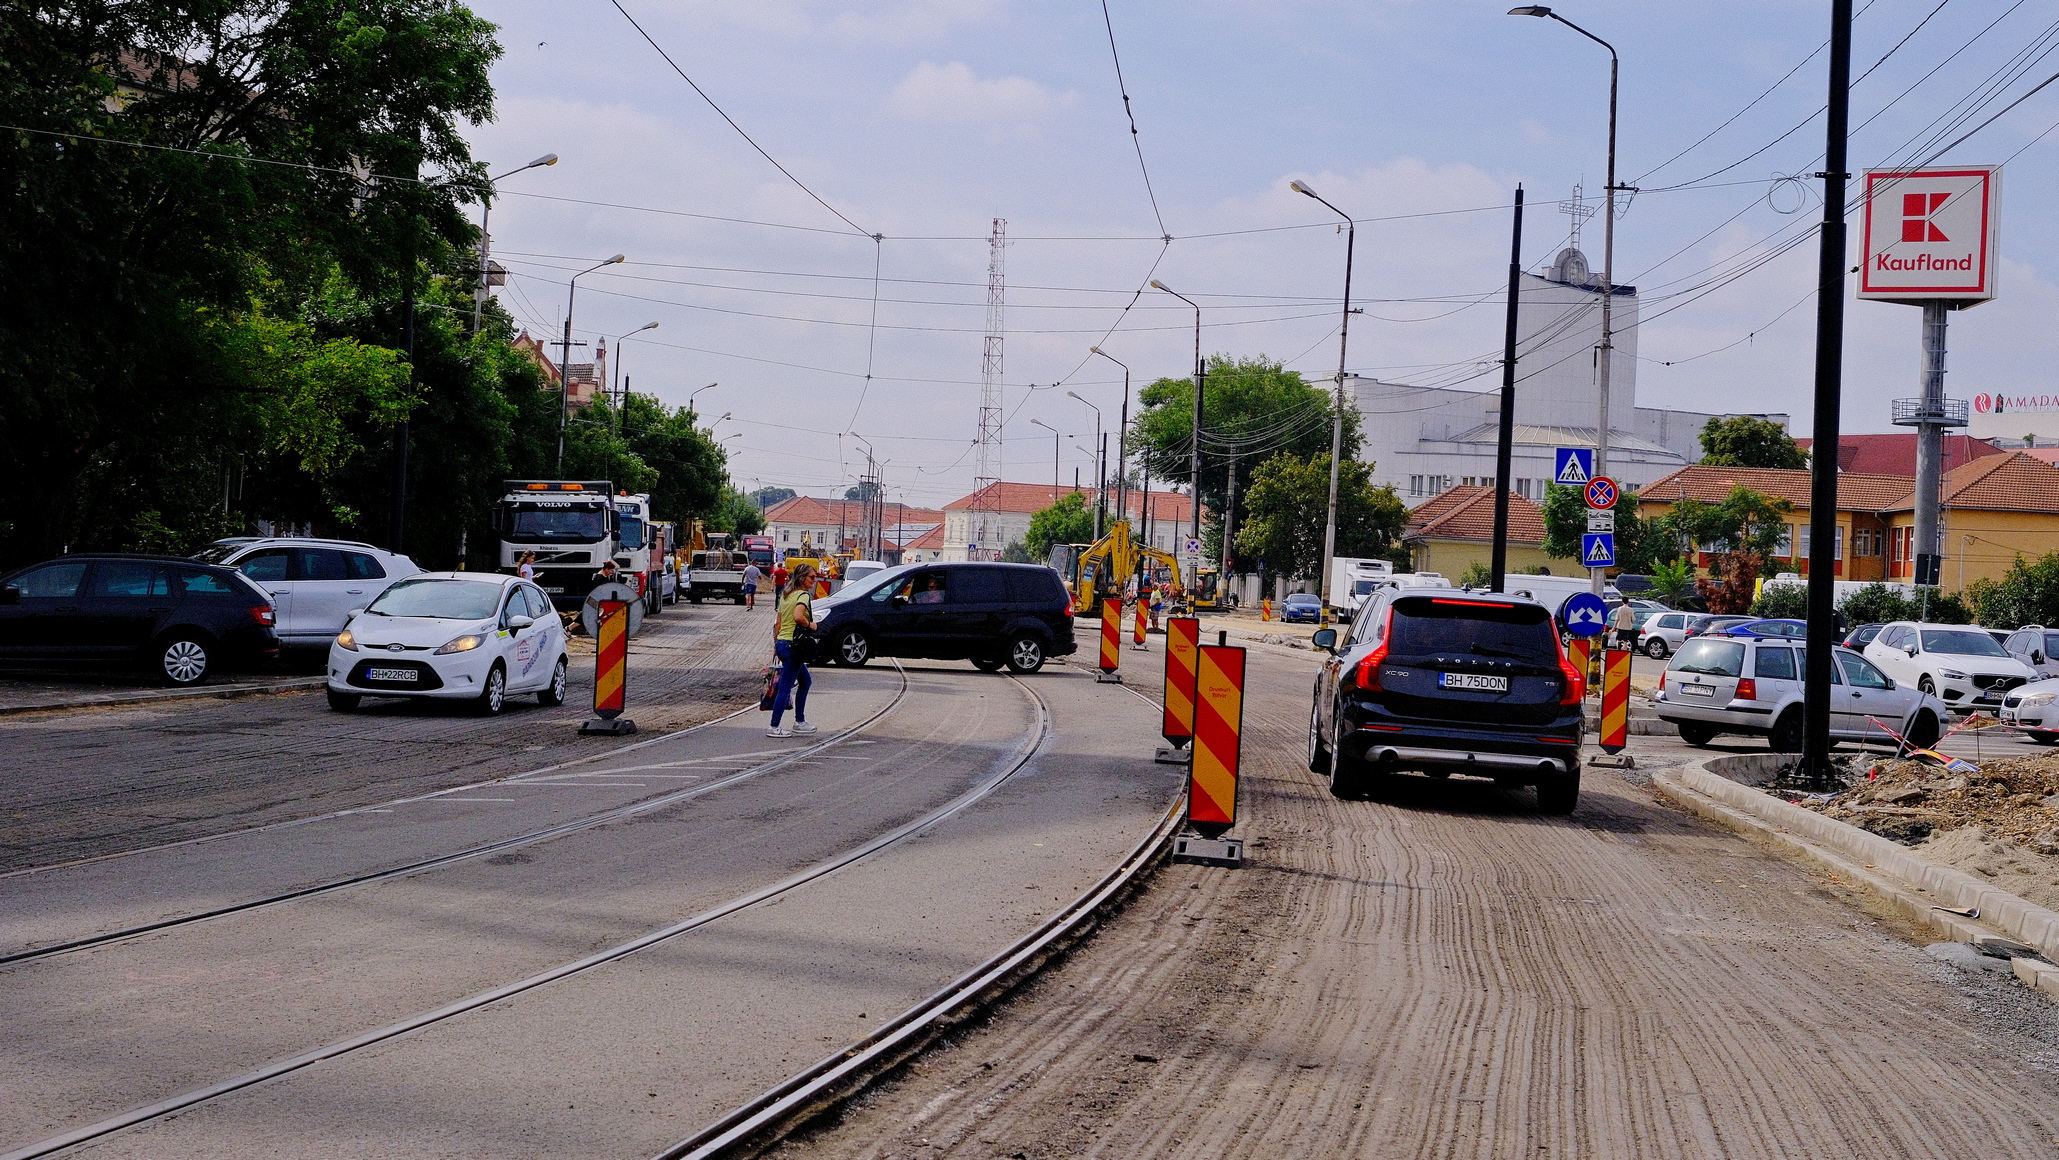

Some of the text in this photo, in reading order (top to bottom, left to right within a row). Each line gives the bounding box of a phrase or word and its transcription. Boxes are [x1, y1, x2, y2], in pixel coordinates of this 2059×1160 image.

[1877, 253, 1972, 271] Kaufland
[1437, 657, 1511, 668] VOLVO
[1446, 674, 1506, 689] BH 75DON
